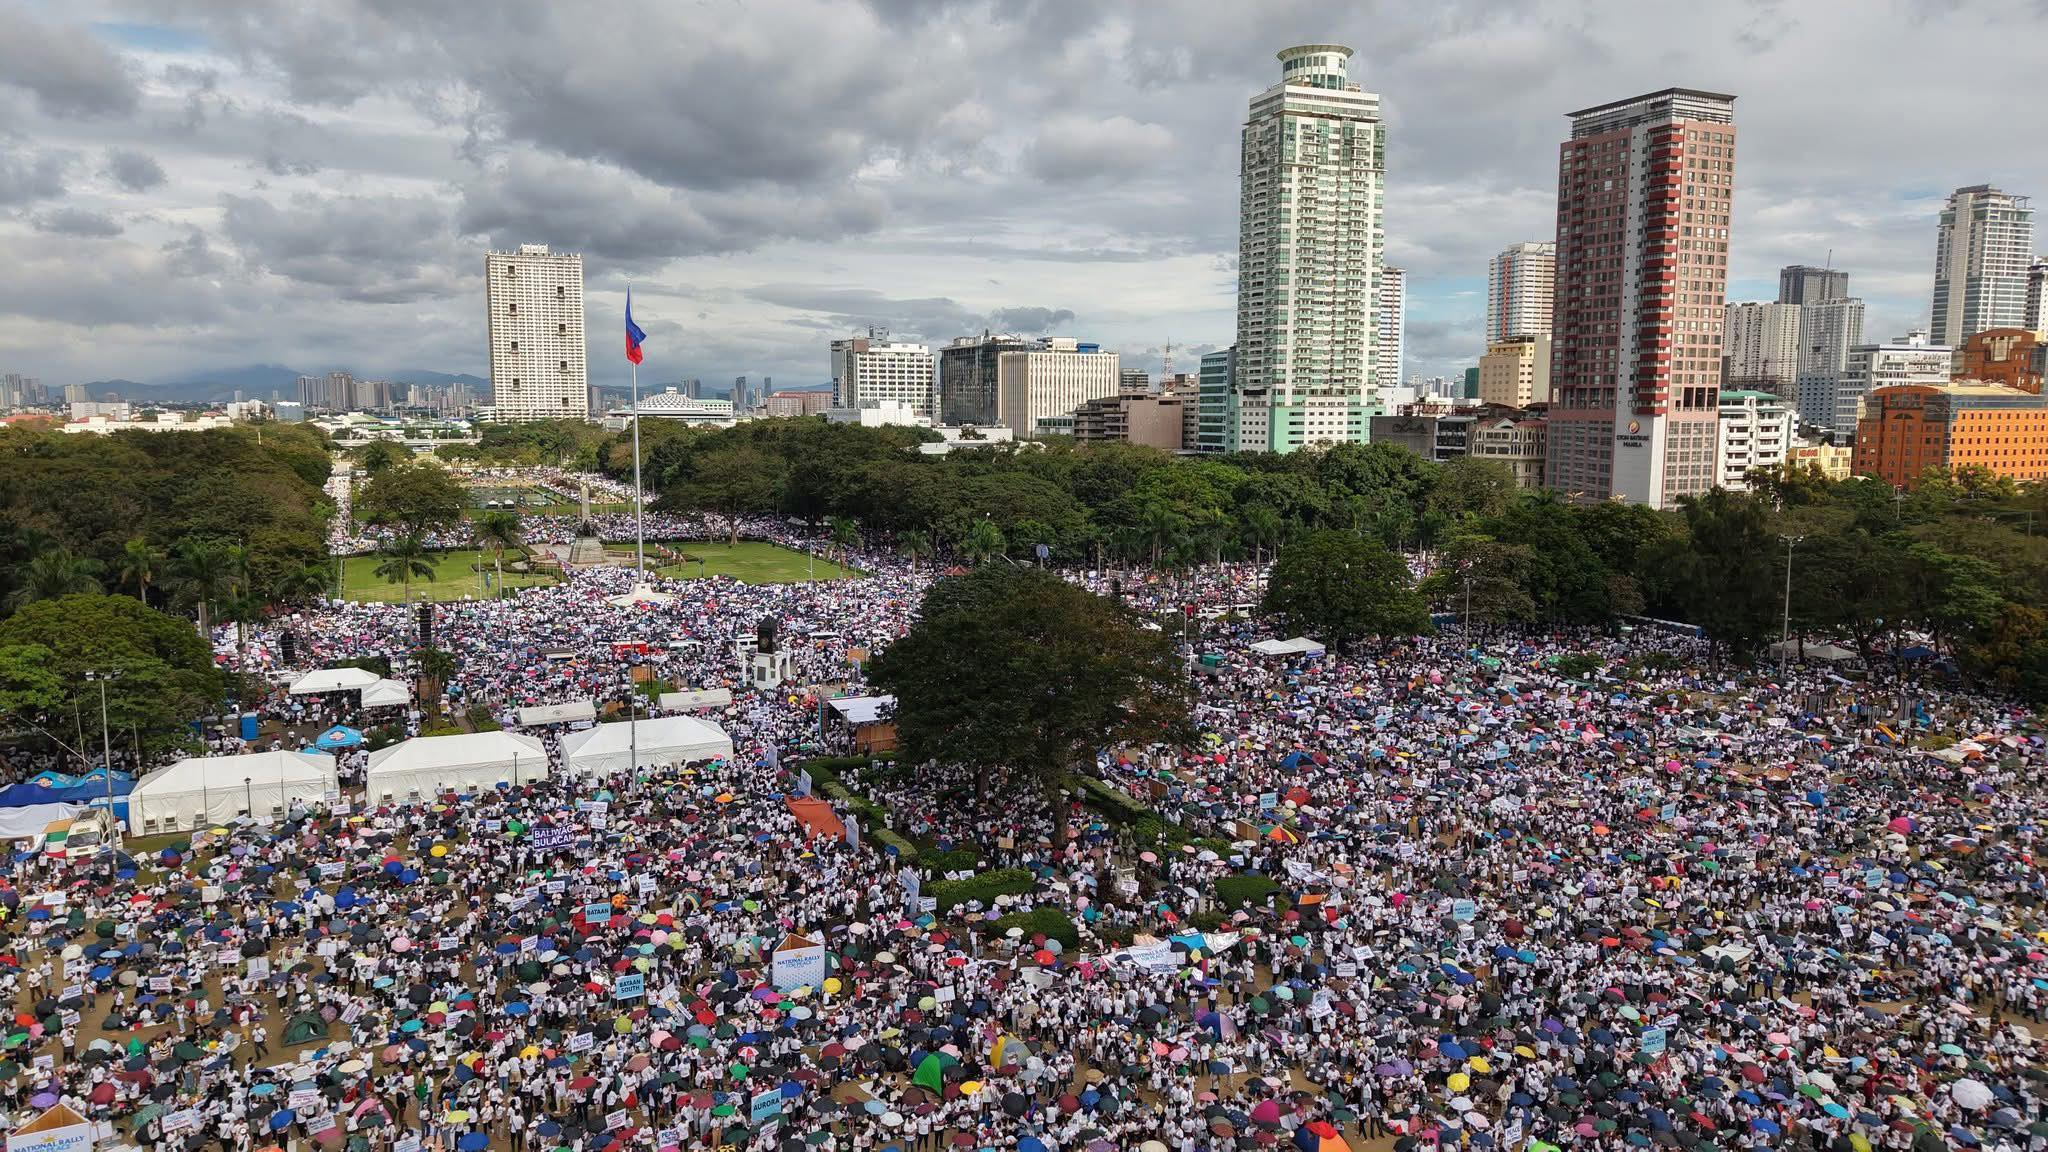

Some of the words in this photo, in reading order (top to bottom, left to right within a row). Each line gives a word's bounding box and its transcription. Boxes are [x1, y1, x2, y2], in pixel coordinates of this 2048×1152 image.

[535, 833, 574, 847] BULACAN
[777, 957, 803, 965] NATIONAL
[619, 978, 640, 987] BATAAN
[621, 985, 640, 993] SOUTH
[574, 1034, 590, 1044] PEACE
[753, 1096, 780, 1111] AURORA
[14, 1142, 56, 1152] NATIONAL
[59, 1135, 85, 1146] RALLY
